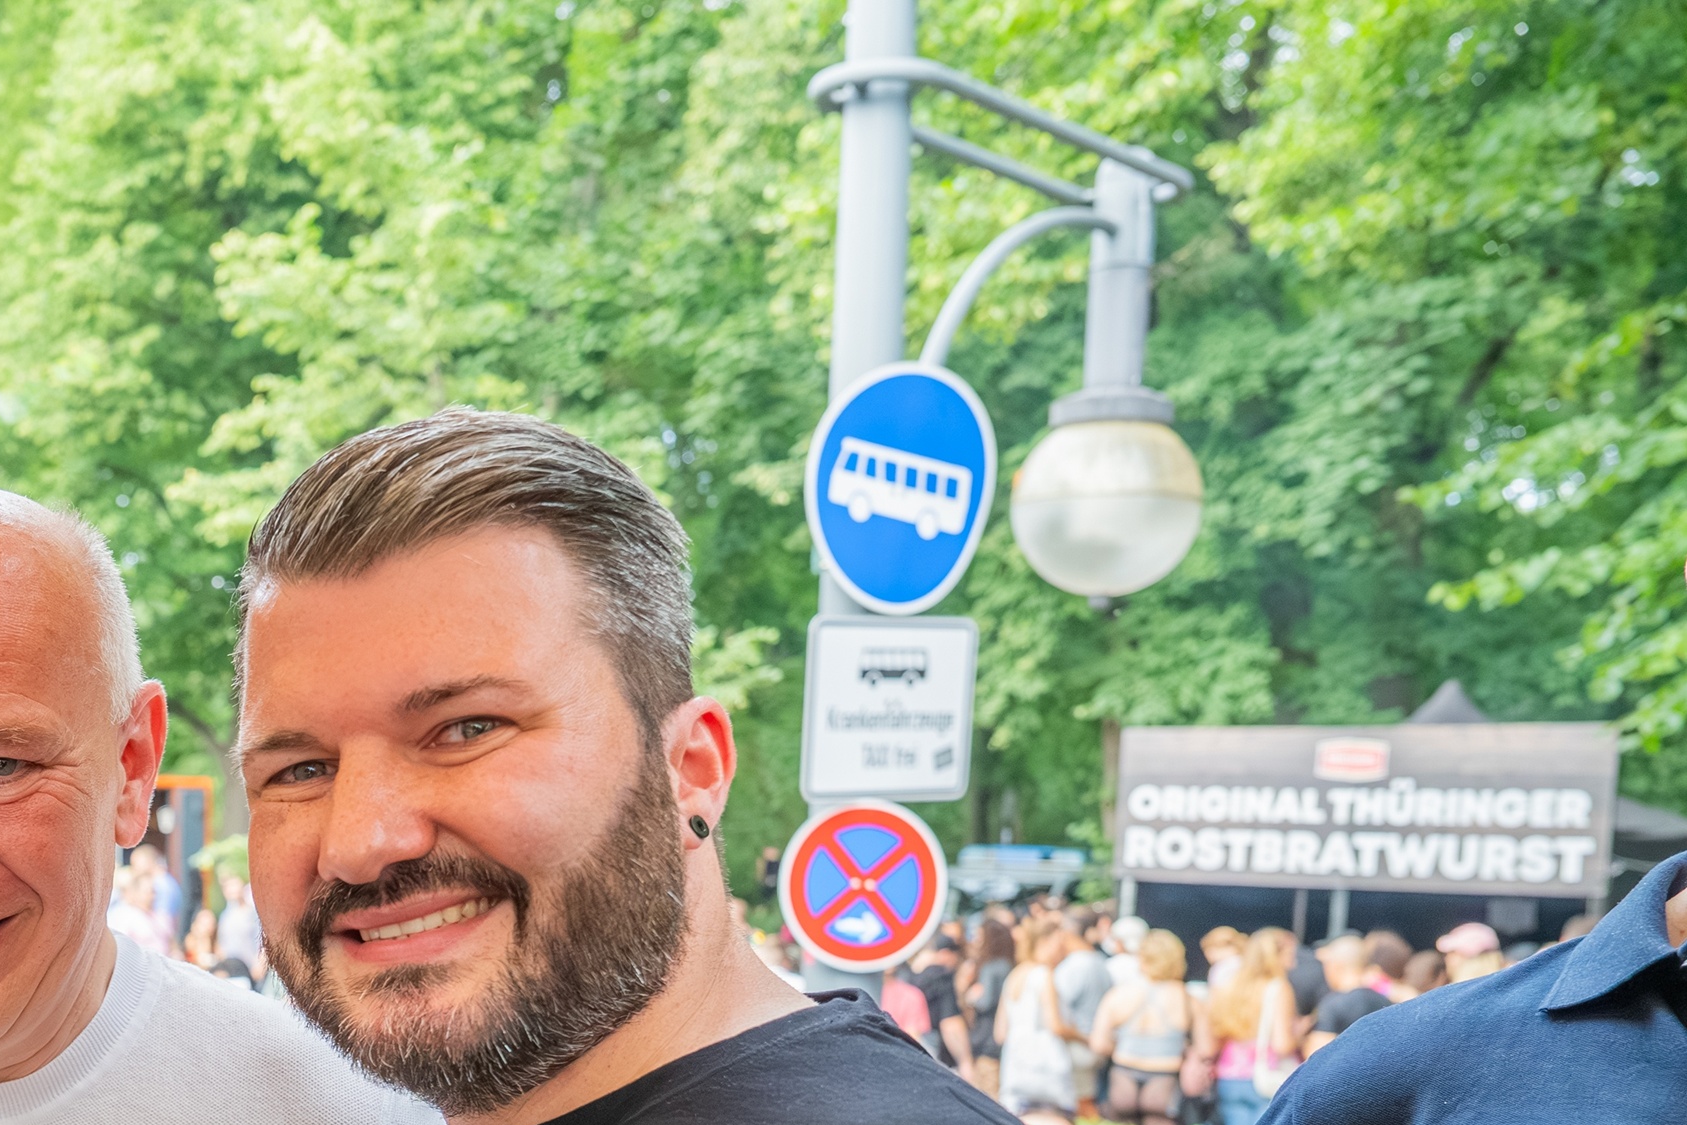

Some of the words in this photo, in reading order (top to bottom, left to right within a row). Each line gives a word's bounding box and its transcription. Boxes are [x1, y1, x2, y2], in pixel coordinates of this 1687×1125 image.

[1127, 784, 1327, 826] ORIGINAL
[1327, 777, 1592, 830] THÜRINGER
[1123, 826, 1597, 884] ROSTBRATWURST
